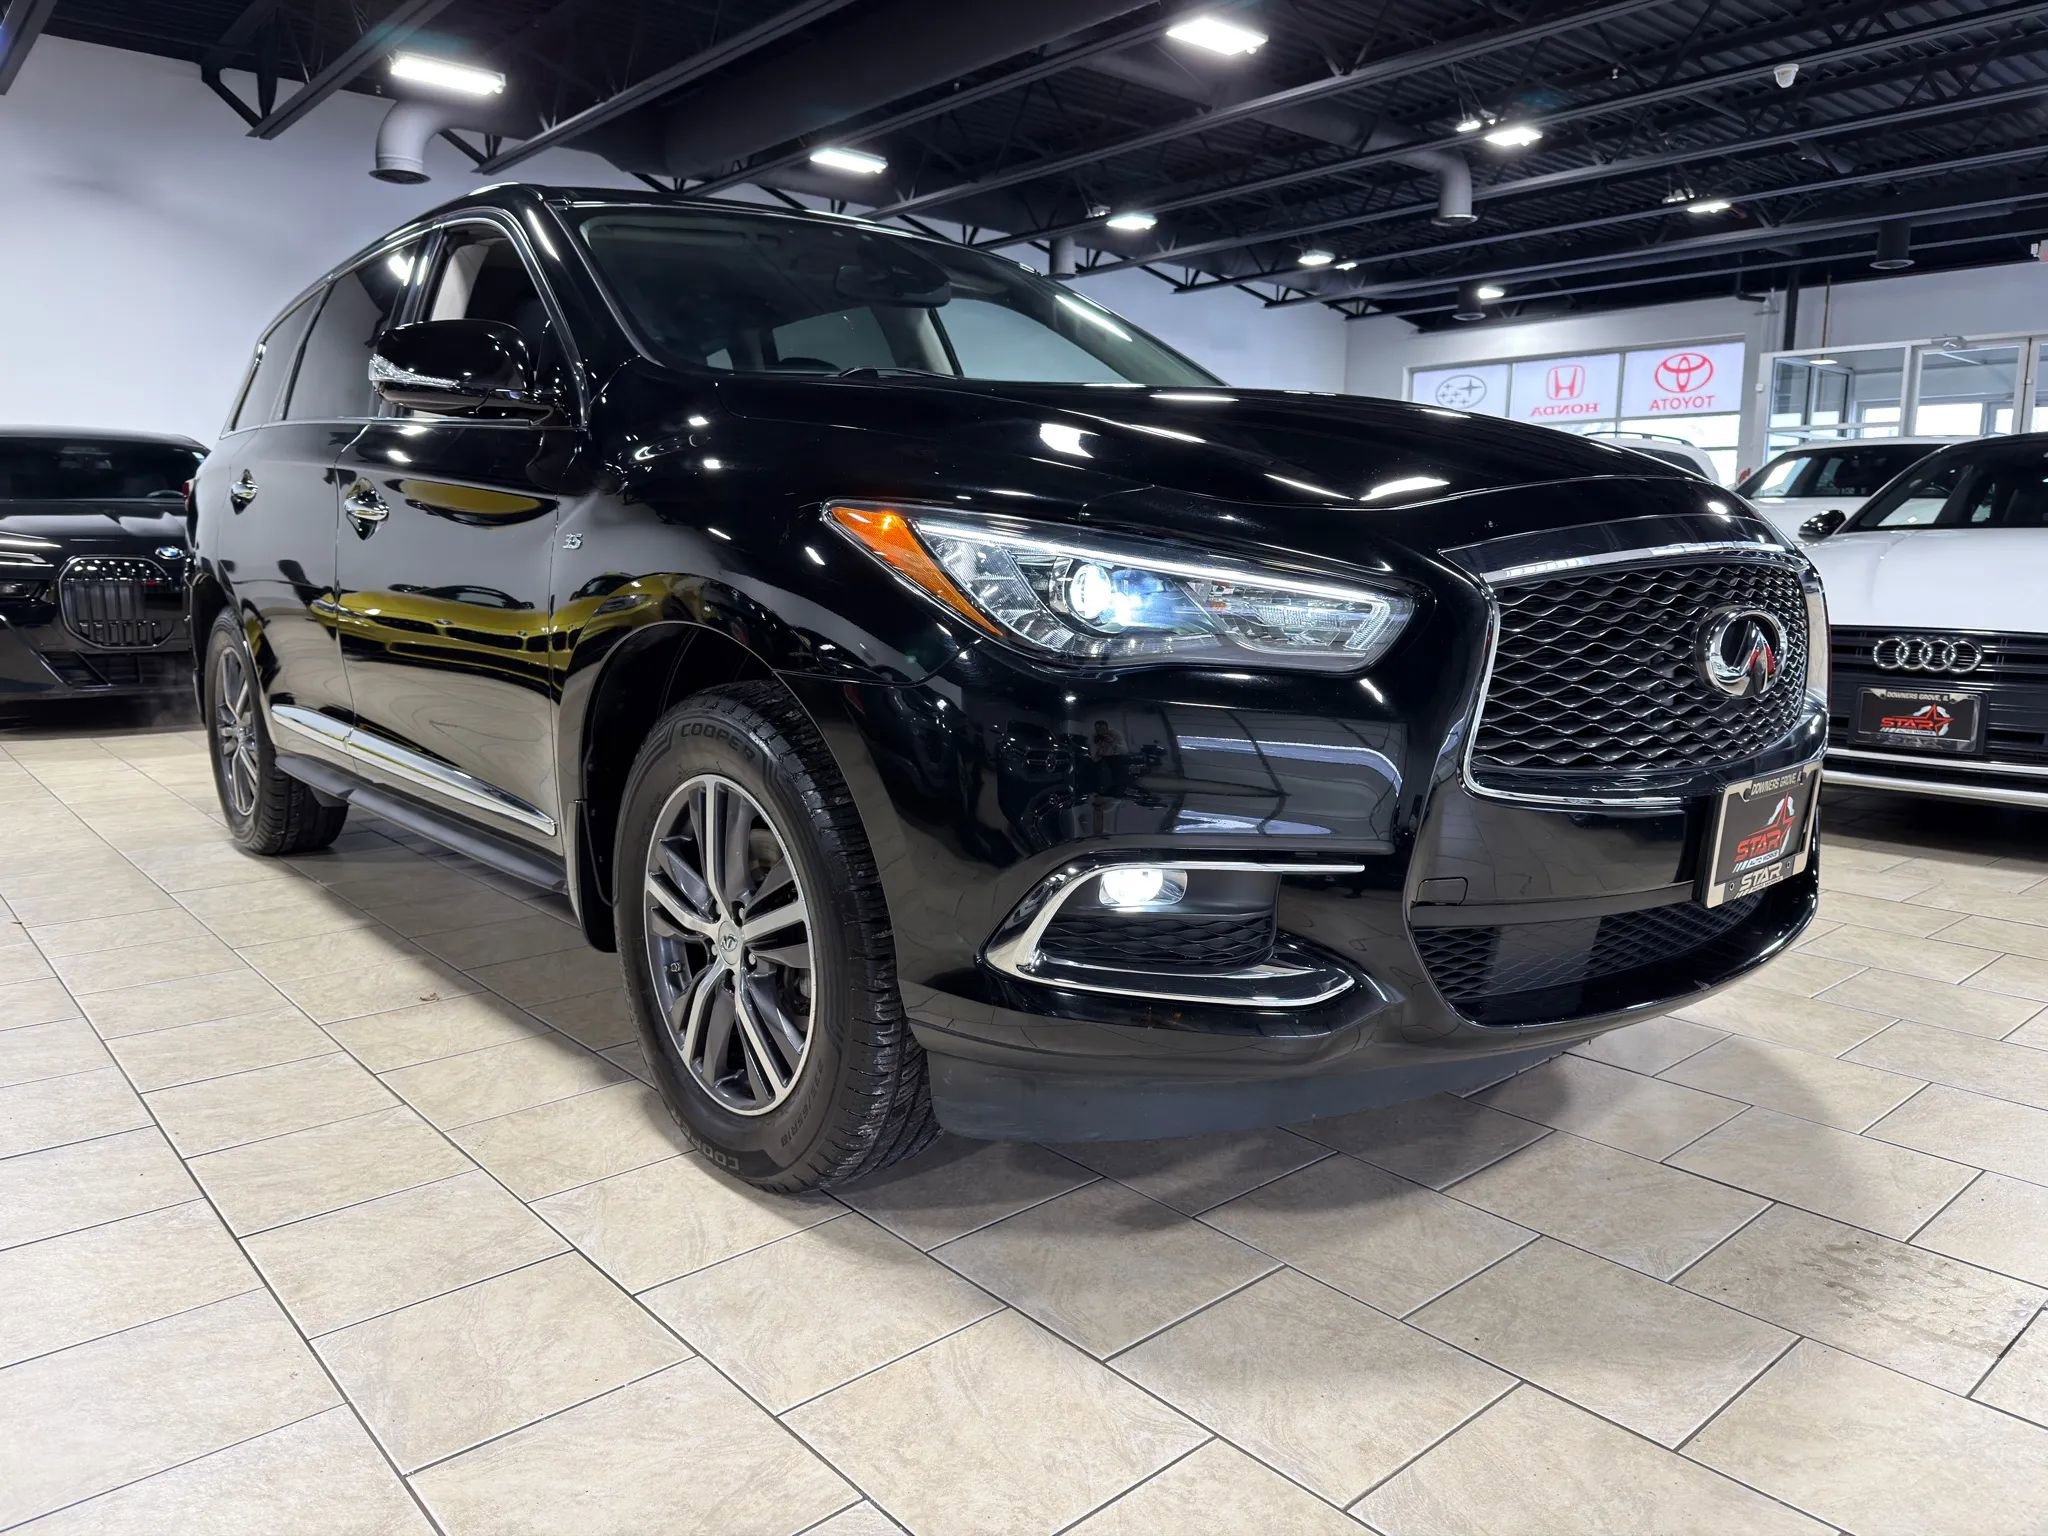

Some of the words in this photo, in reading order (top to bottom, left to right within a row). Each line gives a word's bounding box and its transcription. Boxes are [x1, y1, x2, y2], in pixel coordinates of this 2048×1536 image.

[1880, 717, 1934, 731] STAR
[681, 722, 756, 762] COOPER
[1734, 829, 1782, 862] STAR
[1739, 862, 1783, 891] STAR
